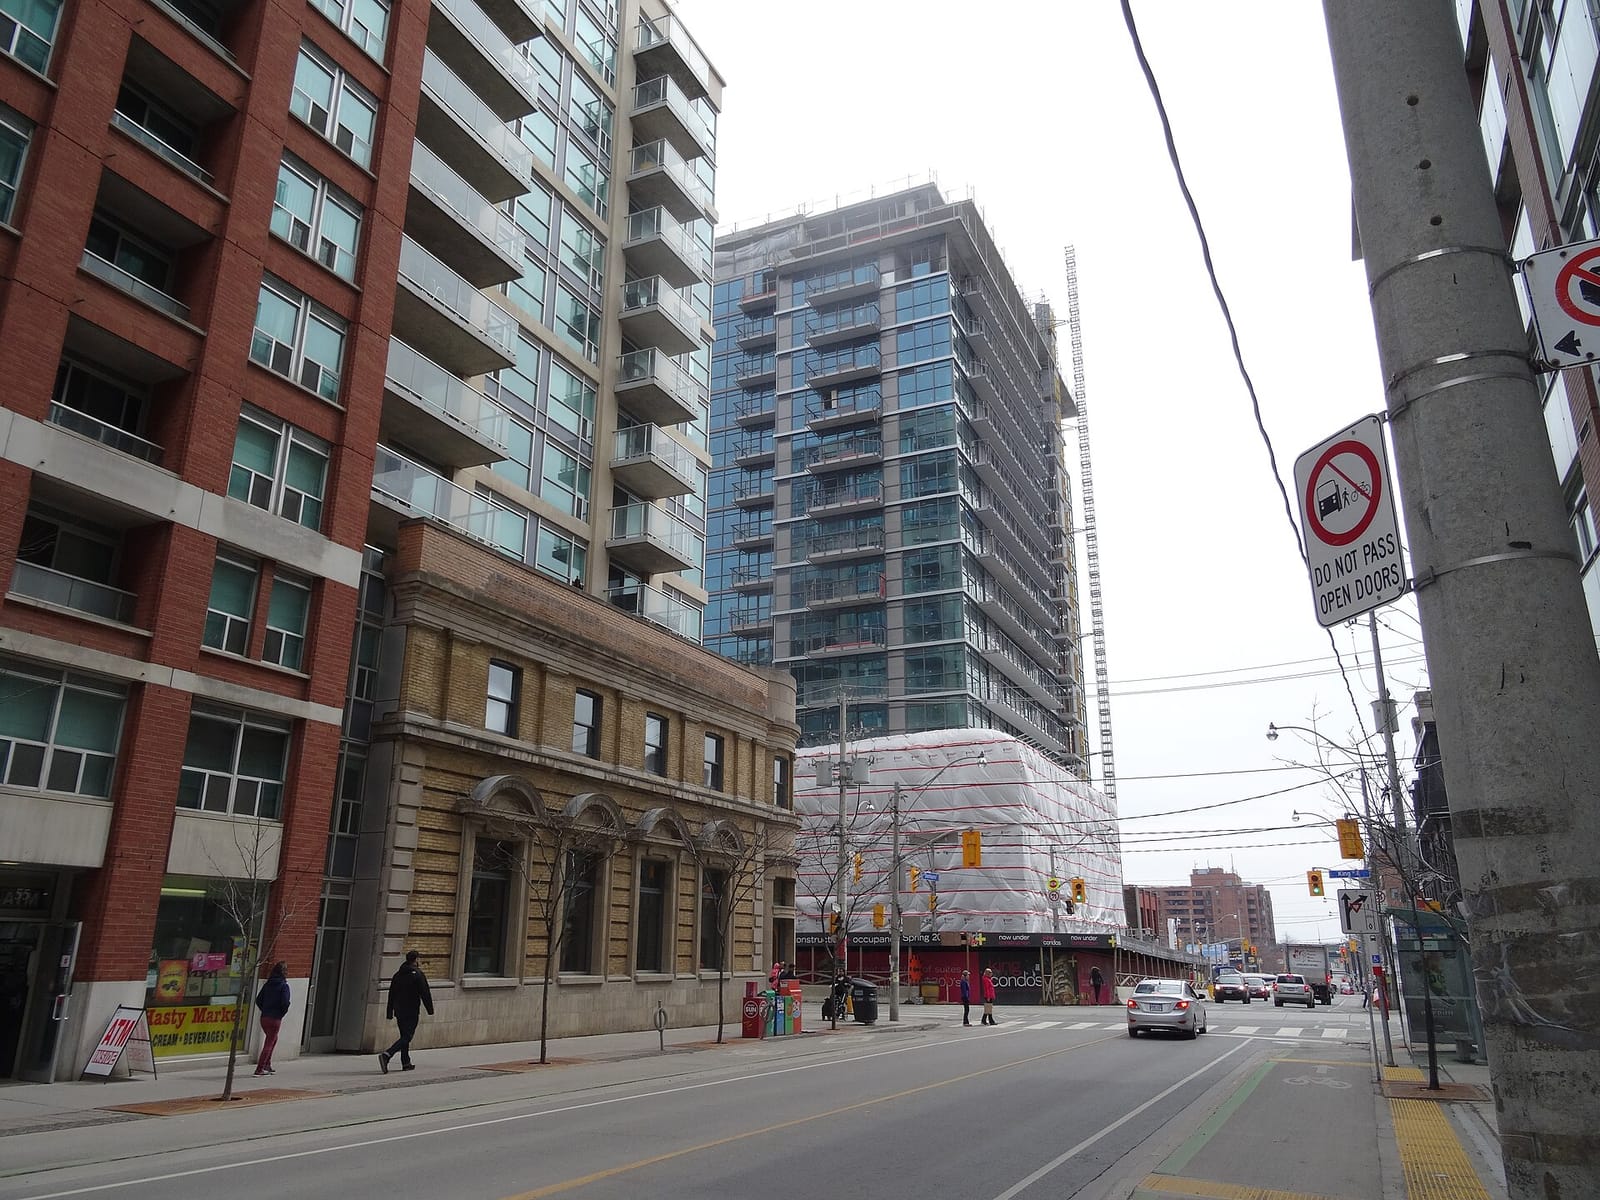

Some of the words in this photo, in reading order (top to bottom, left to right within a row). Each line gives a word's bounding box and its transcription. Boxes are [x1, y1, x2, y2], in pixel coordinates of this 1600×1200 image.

[1314, 563, 1331, 587] DO
[1335, 549, 1358, 578] NOT
[1363, 533, 1395, 565] PASS
[1320, 583, 1352, 615] OPEN
[1355, 563, 1399, 600] DOORS
[852, 936, 891, 945] occupan
[991, 971, 1042, 987] condos
[192, 1006, 243, 1024] Marke
[101, 1018, 136, 1047] ATM
[153, 1033, 179, 1048] CREAM
[183, 1030, 225, 1045] BEVERAGES
